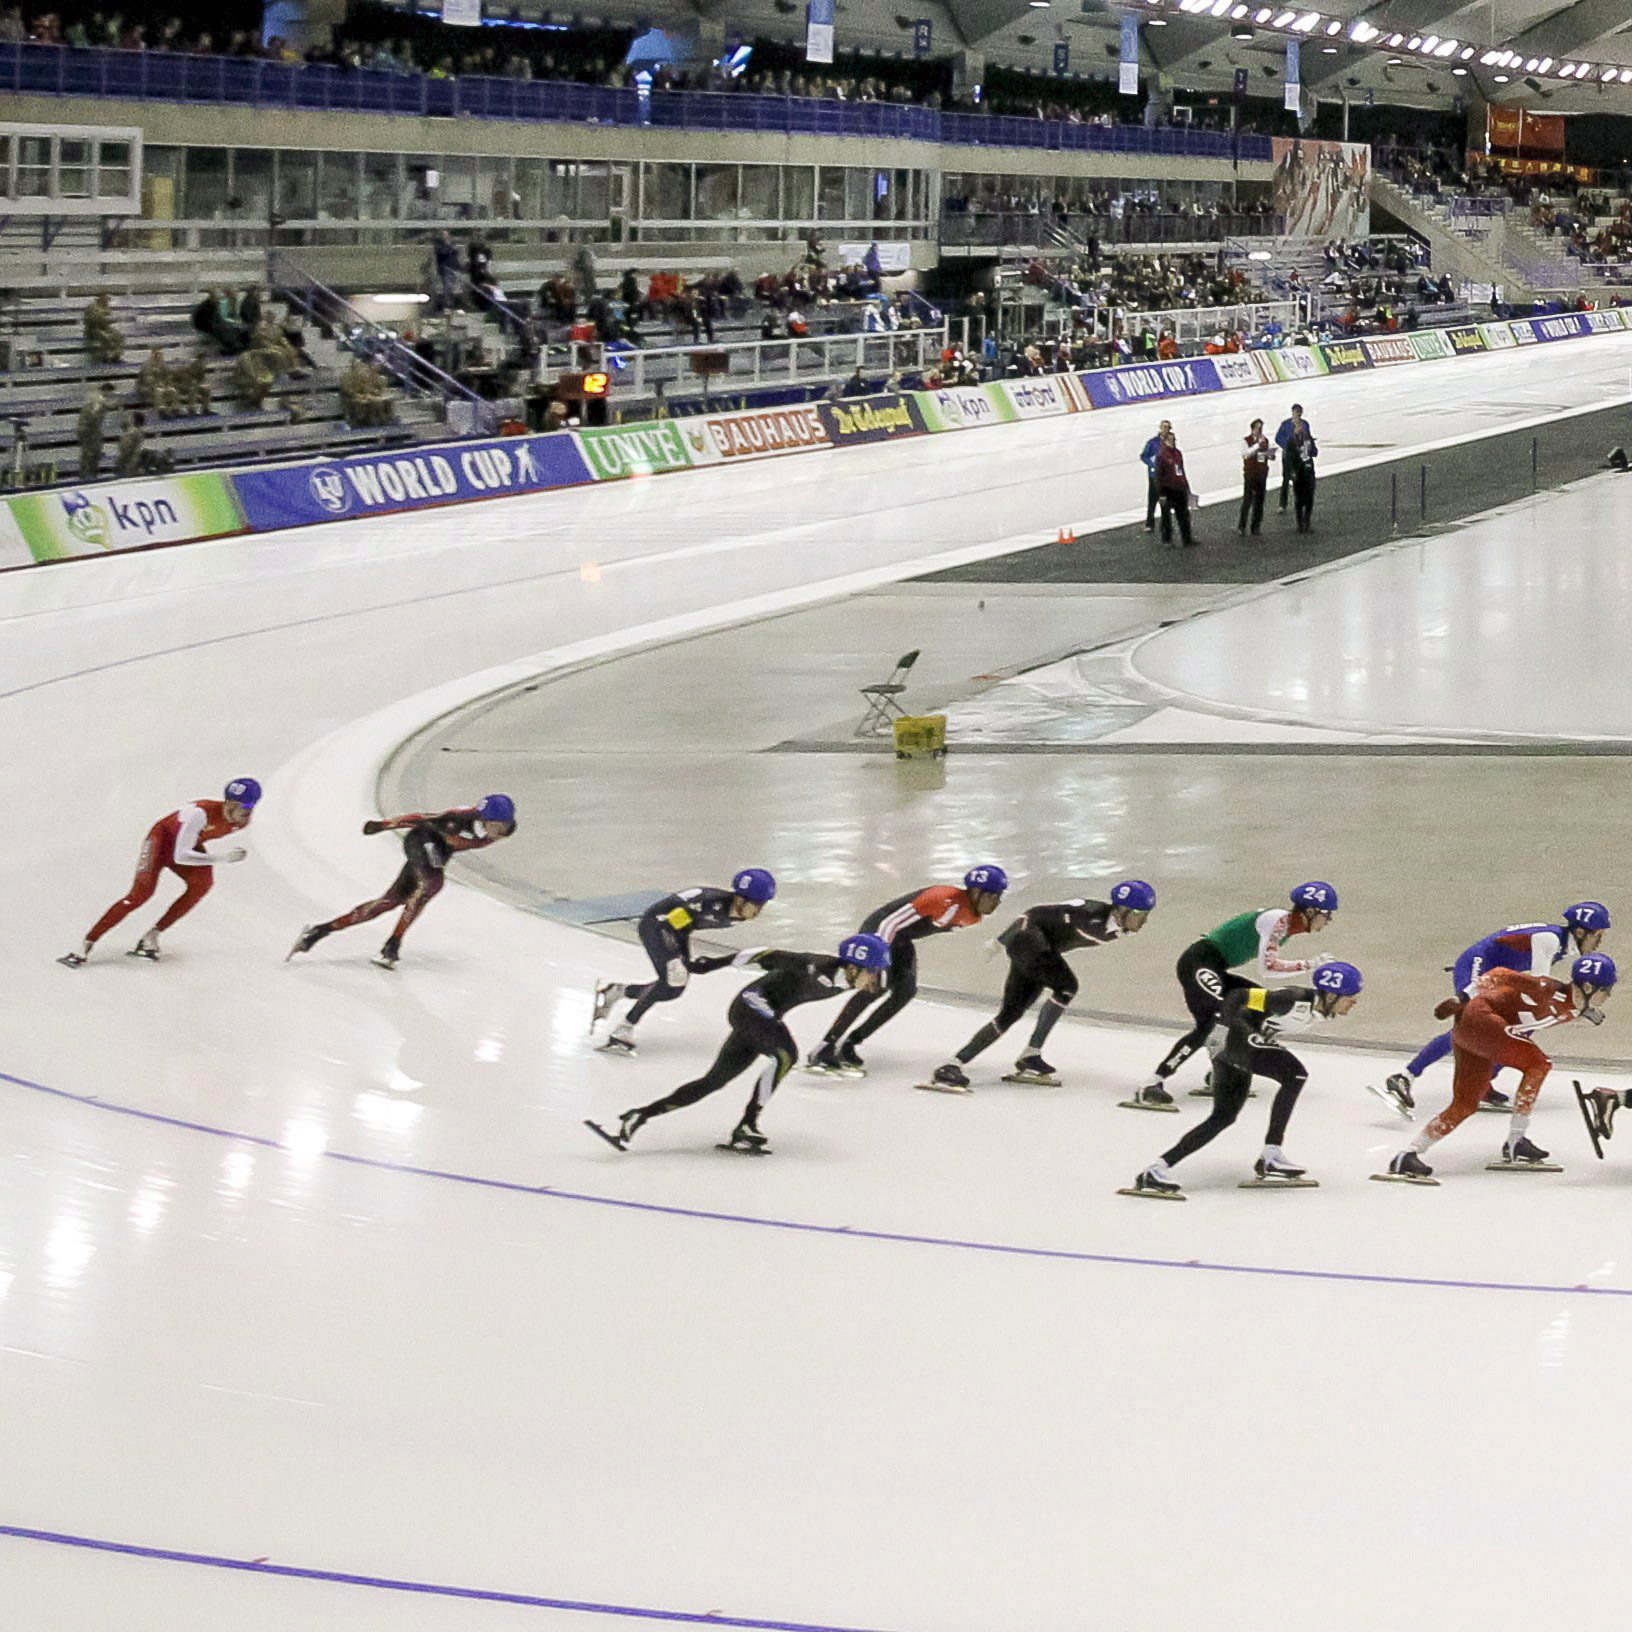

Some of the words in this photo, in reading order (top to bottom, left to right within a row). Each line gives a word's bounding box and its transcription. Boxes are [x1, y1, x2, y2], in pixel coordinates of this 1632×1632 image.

[1117, 368, 1165, 398] WORLD
[961, 393, 991, 418] kpn
[708, 409, 827, 452] BAUHAUS
[344, 455, 458, 506] WORLD
[460, 448, 512, 490] CUP
[108, 495, 179, 536] kpn
[969, 869, 990, 884] 13
[1118, 886, 1131, 899] 9
[1303, 886, 1327, 903] 24
[1575, 908, 1595, 923] 17
[846, 942, 869, 961] 16
[1579, 959, 1603, 975] 21
[1318, 970, 1345, 989] 23
